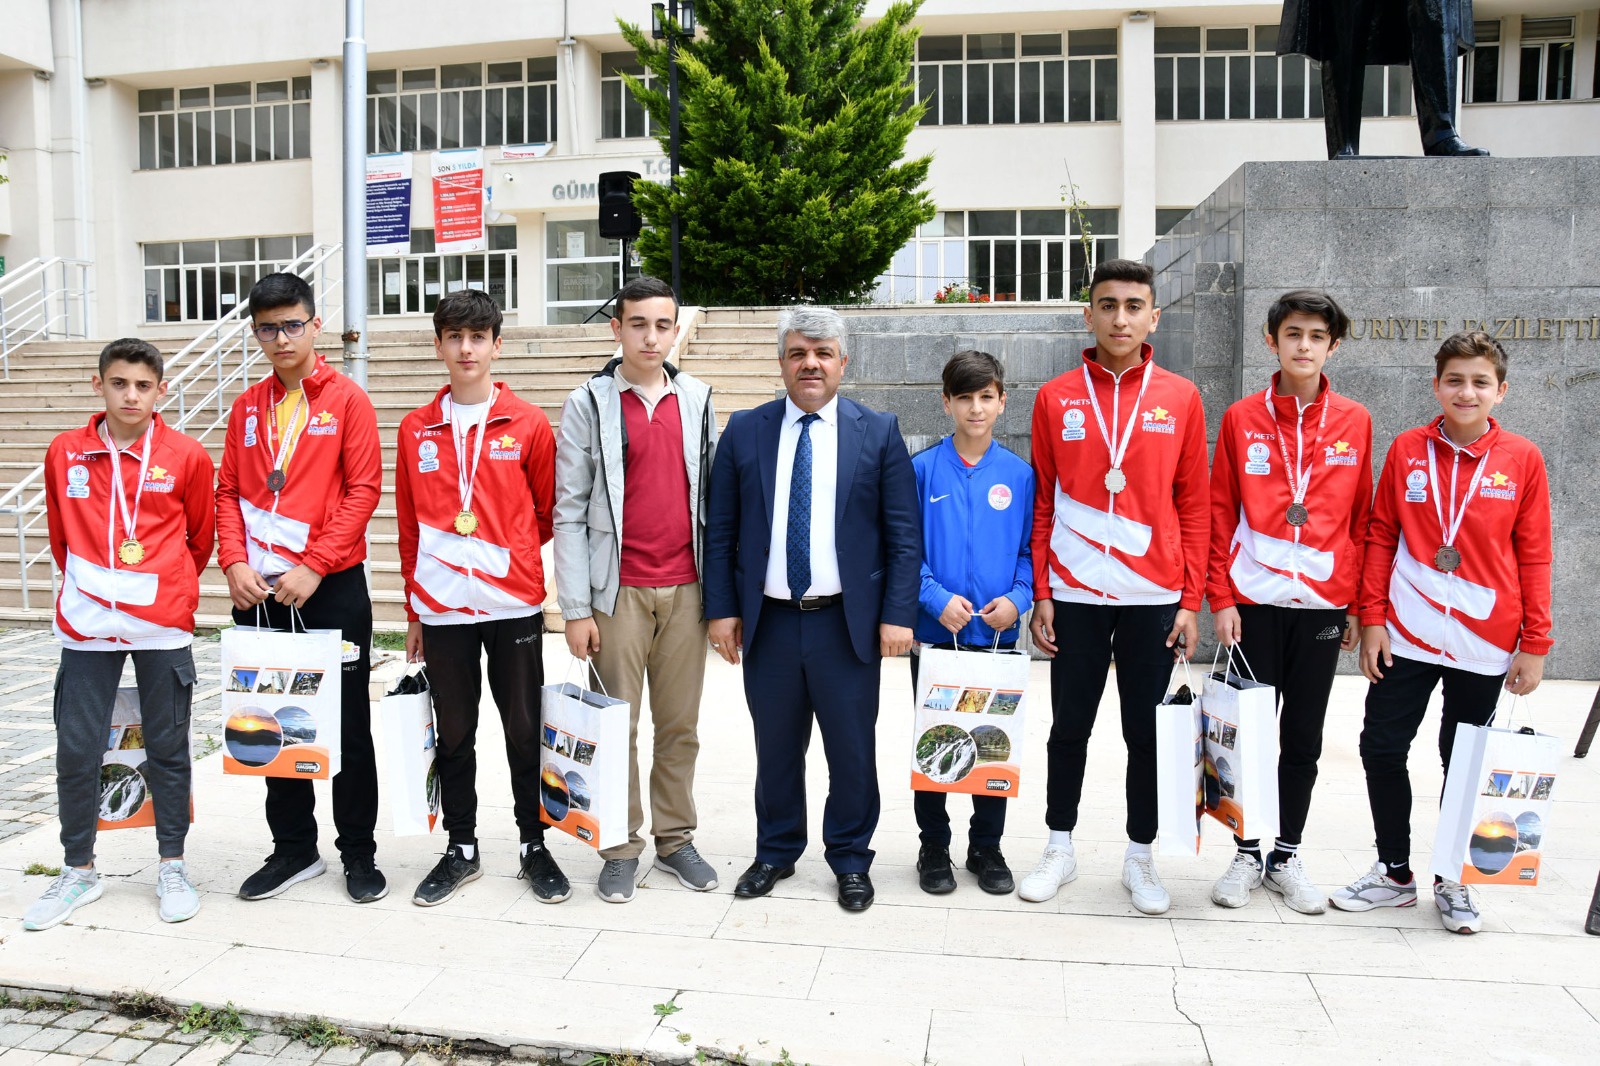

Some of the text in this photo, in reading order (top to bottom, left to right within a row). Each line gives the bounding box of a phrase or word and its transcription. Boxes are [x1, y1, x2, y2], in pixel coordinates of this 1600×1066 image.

[458, 162, 477, 170] YILDA
[552, 180, 596, 200] GÜM
[1348, 314, 1600, 340] URİYET FAZİLETTİ
[1069, 398, 1091, 406] METS
[1253, 432, 1275, 440] METS
[76, 454, 97, 462] METS
